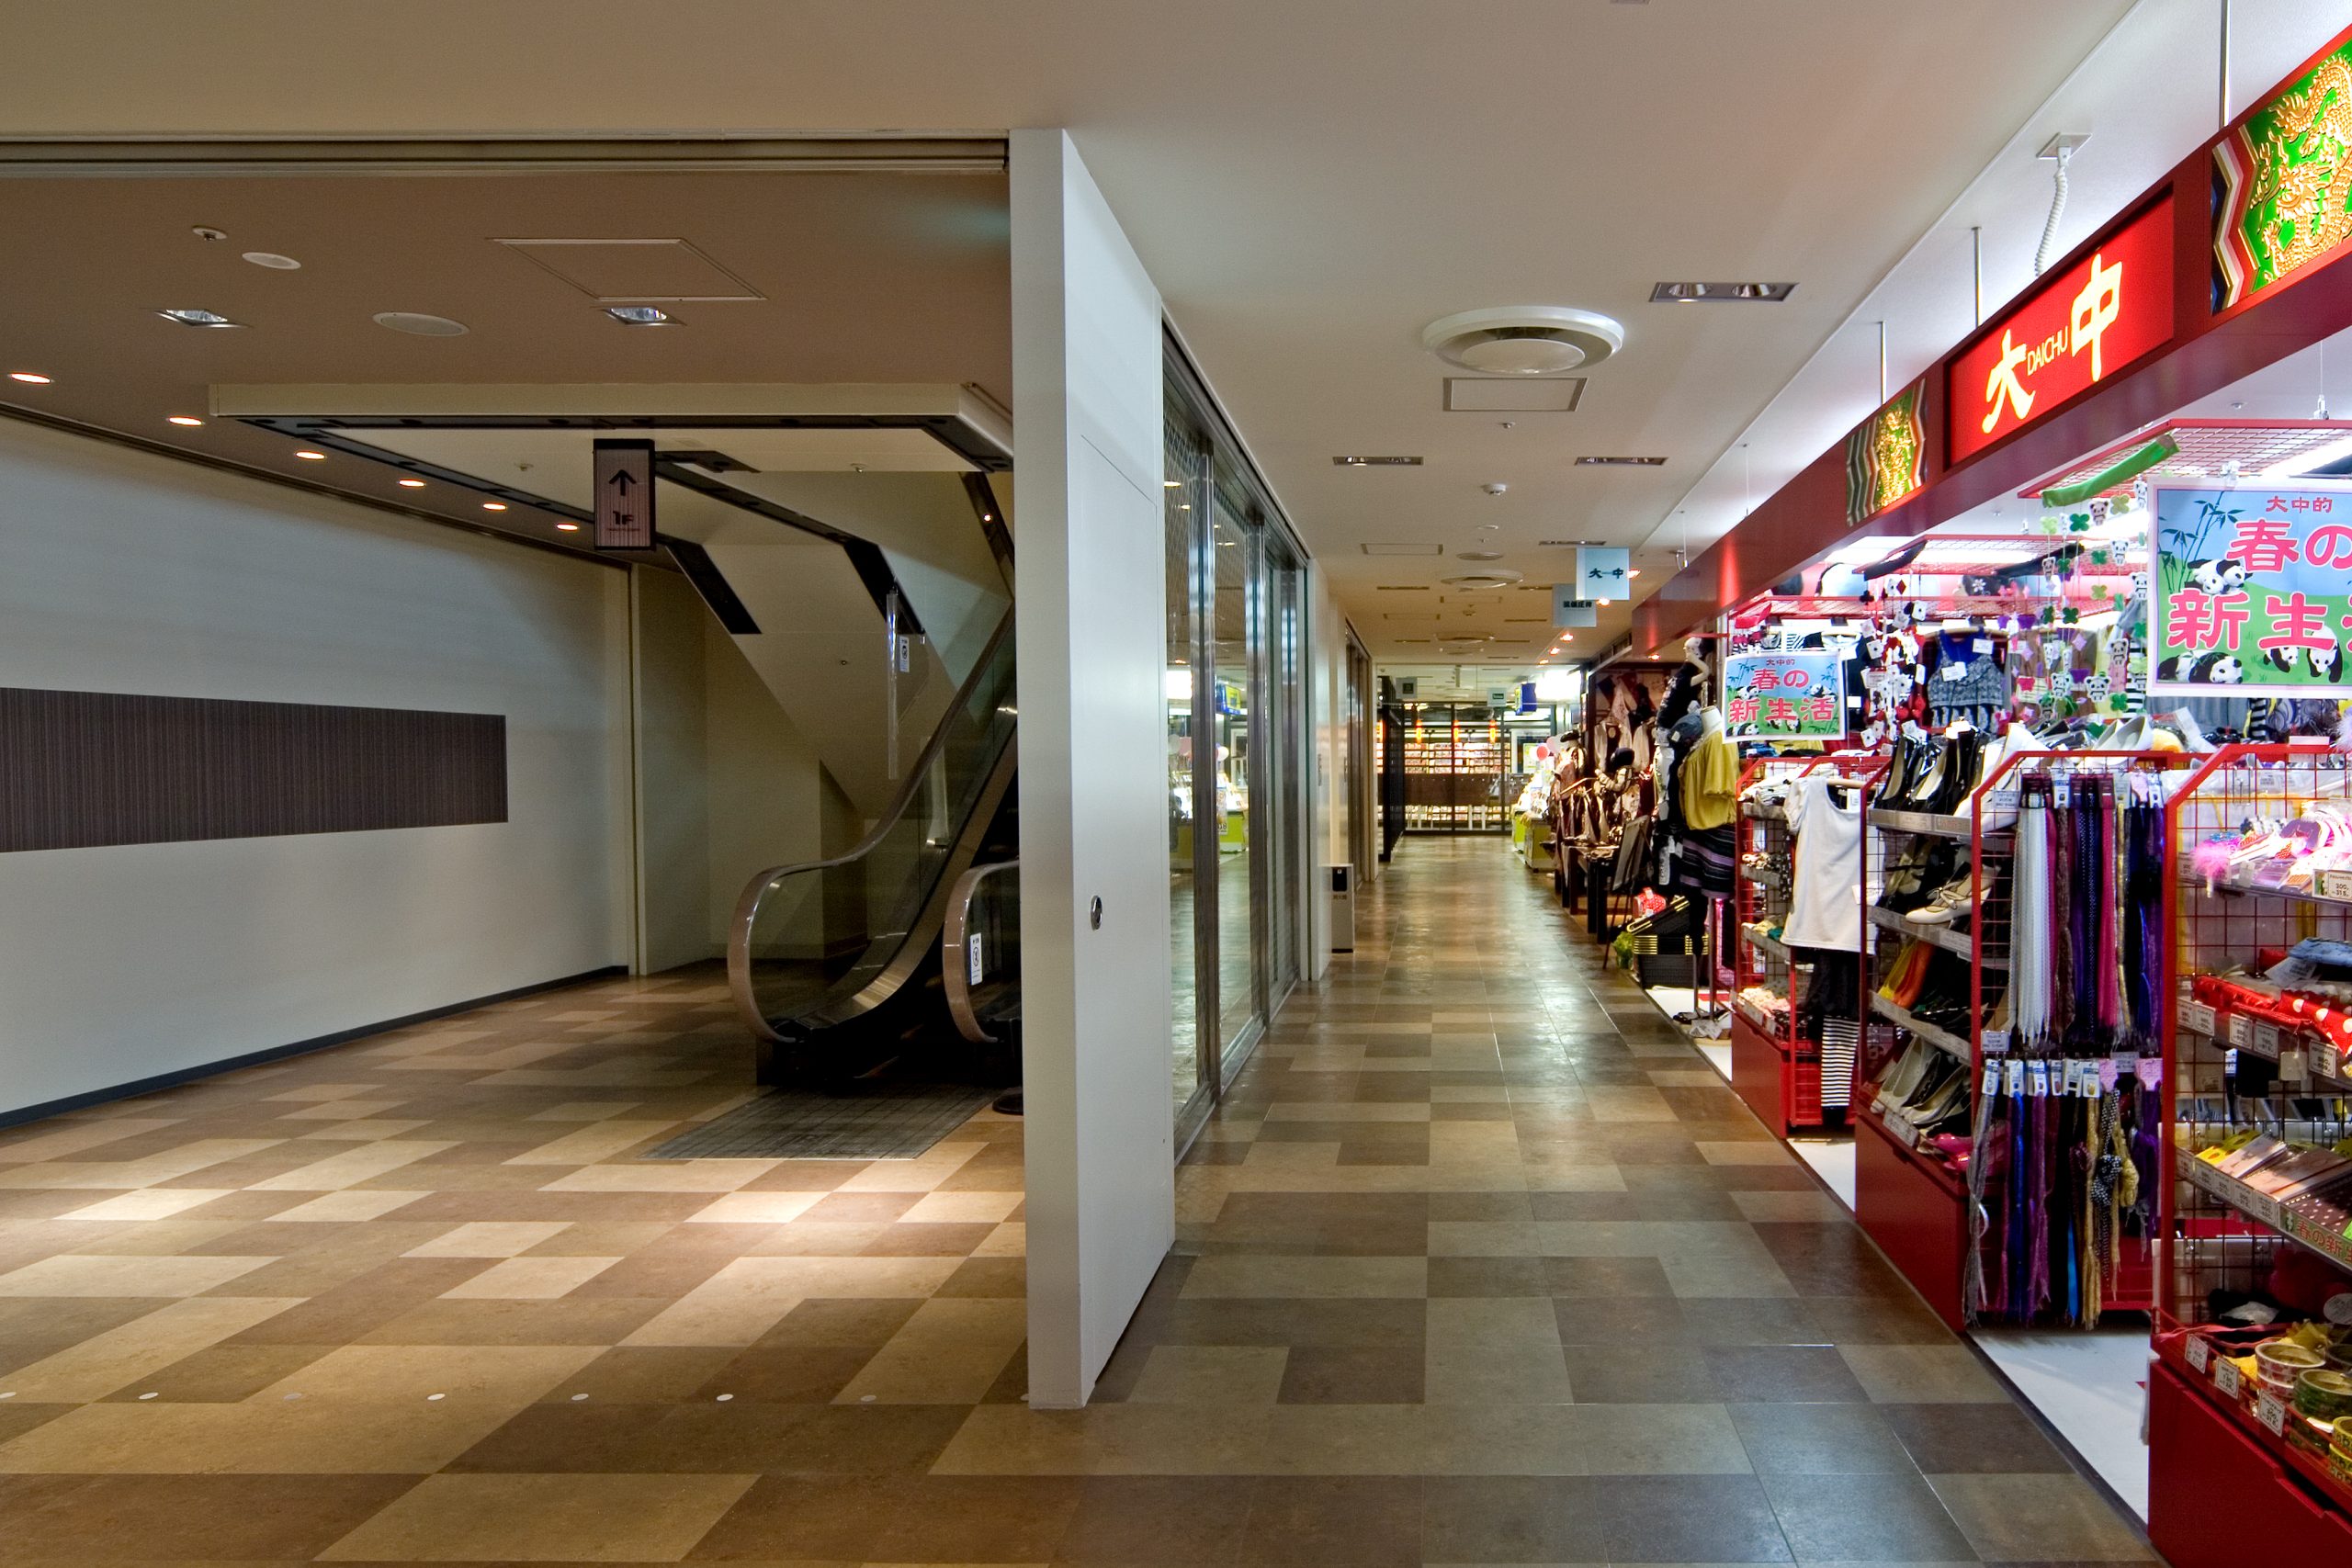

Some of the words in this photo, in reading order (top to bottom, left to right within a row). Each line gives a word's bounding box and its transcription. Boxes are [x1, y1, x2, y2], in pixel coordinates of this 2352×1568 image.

[2027, 325, 2068, 377] DAICHU
[2266, 495, 2333, 513] 大中的
[613, 511, 634, 525] 1F
[2225, 518, 2352, 572] 春の
[2167, 587, 2352, 650] 新生
[1750, 668, 1809, 690] 春の
[1729, 698, 1836, 723] 新生活
